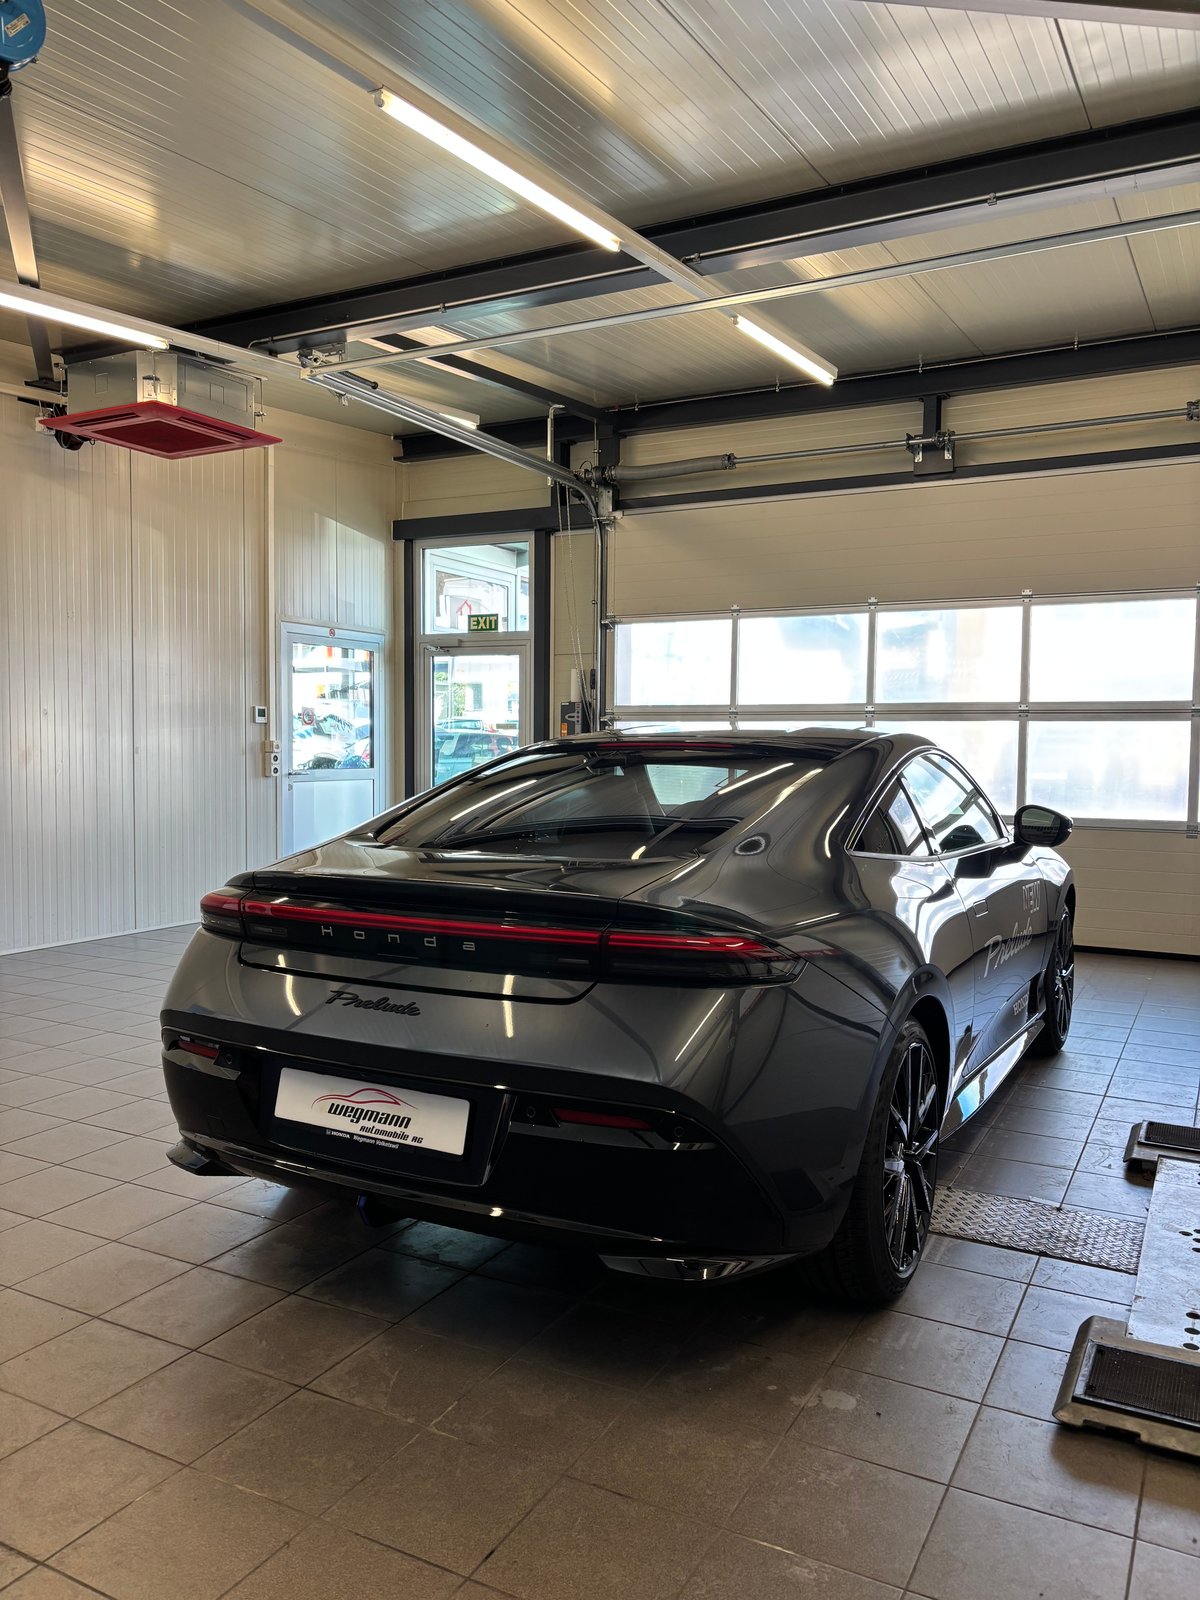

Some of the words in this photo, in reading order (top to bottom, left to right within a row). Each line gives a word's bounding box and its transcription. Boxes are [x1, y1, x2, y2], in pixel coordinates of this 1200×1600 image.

[470, 616, 497, 630] EXIT
[984, 918, 1032, 978] Prelude
[325, 990, 421, 1016] Prelude
[328, 1103, 411, 1129] wegmann
[331, 1130, 351, 1139] HONDA
